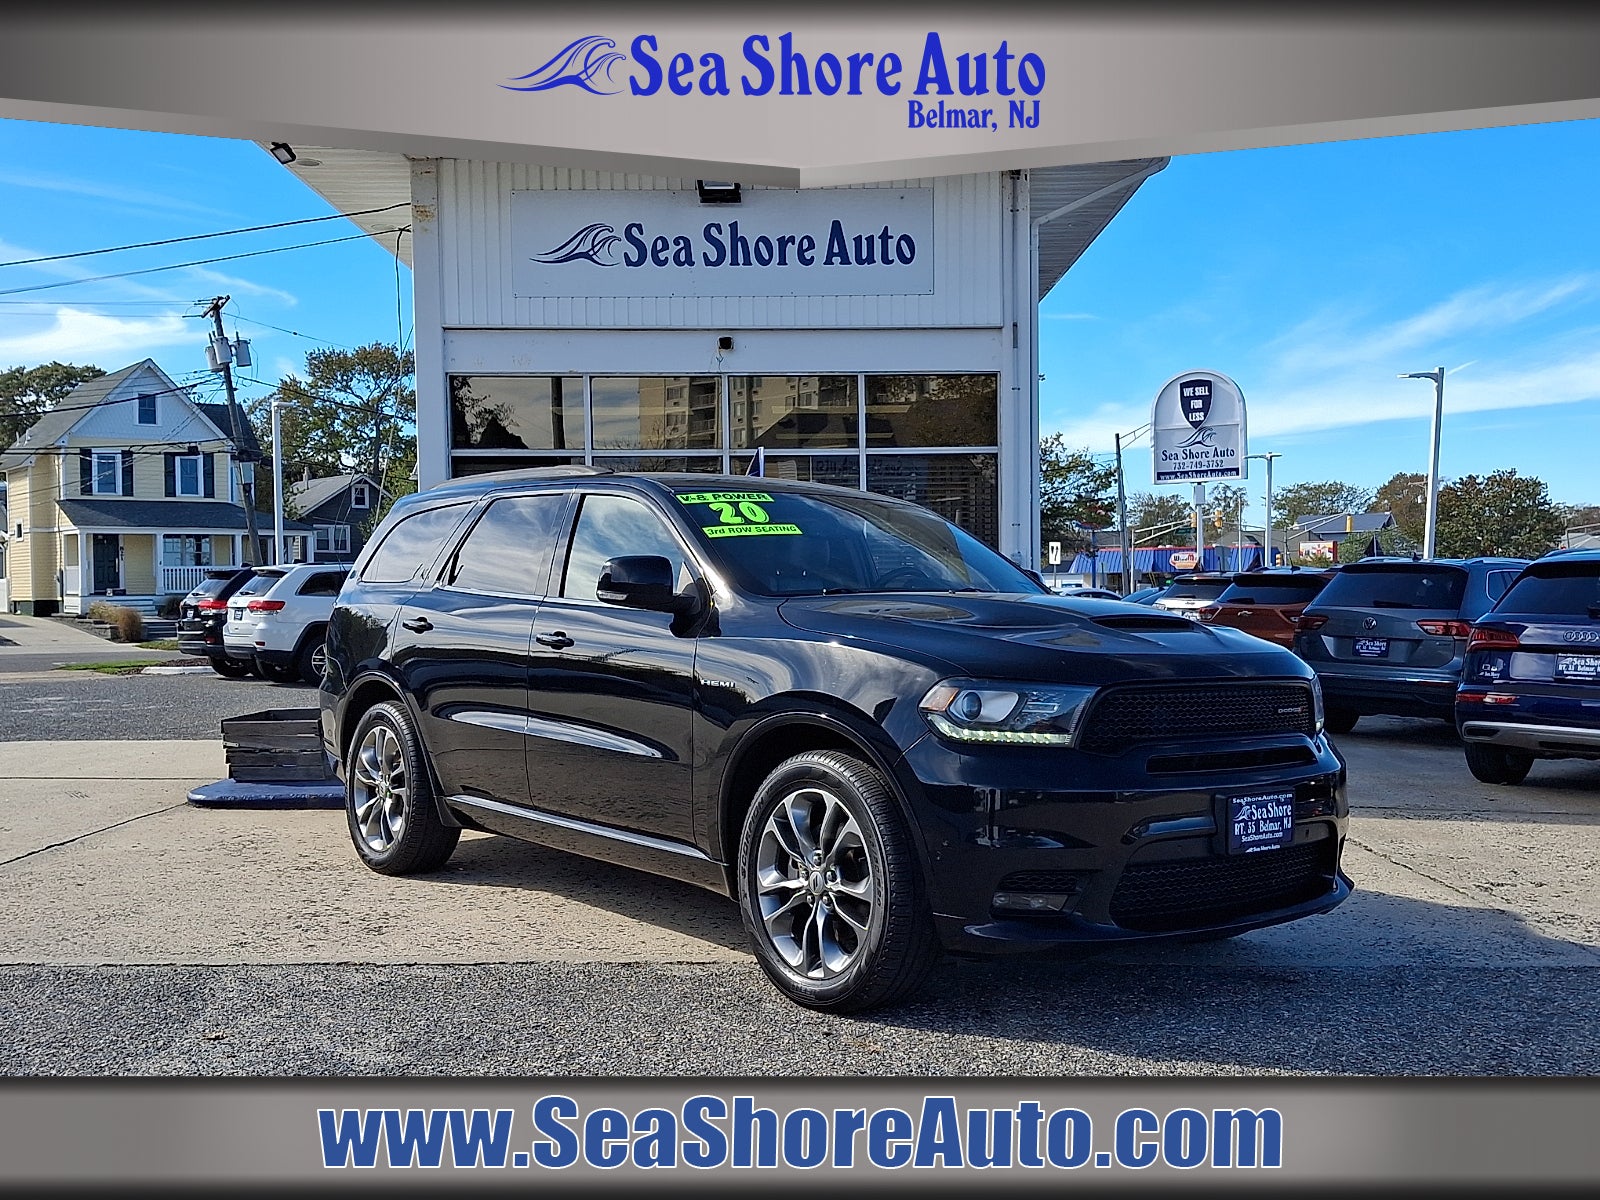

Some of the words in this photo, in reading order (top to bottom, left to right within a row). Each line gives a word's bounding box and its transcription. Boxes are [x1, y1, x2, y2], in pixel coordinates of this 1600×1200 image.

[623, 222, 696, 267] Sea
[702, 220, 816, 267] Shore
[822, 219, 916, 266] Auto
[1183, 387, 1194, 397] WE
[1195, 386, 1210, 396] SELL
[1190, 399, 1203, 410] FOR
[1188, 411, 1205, 422] LESS
[1161, 449, 1179, 461] Sea
[1181, 448, 1210, 460] Shore
[1212, 446, 1235, 459] Auto
[1173, 460, 1224, 471] 732-749-3752
[711, 493, 769, 501] POWER
[708, 501, 770, 524] 20
[707, 528, 726, 536] 3rd
[755, 525, 797, 533] SEATING
[700, 679, 736, 688] HEMI
[1232, 793, 1293, 804] SeaShoreAuto.com
[1251, 804, 1267, 820] Sea
[1267, 802, 1292, 818] Shore
[1234, 822, 1246, 836] RT.
[1247, 821, 1256, 834] 35
[1259, 819, 1282, 833] Belmar,
[1283, 816, 1292, 830] NJ
